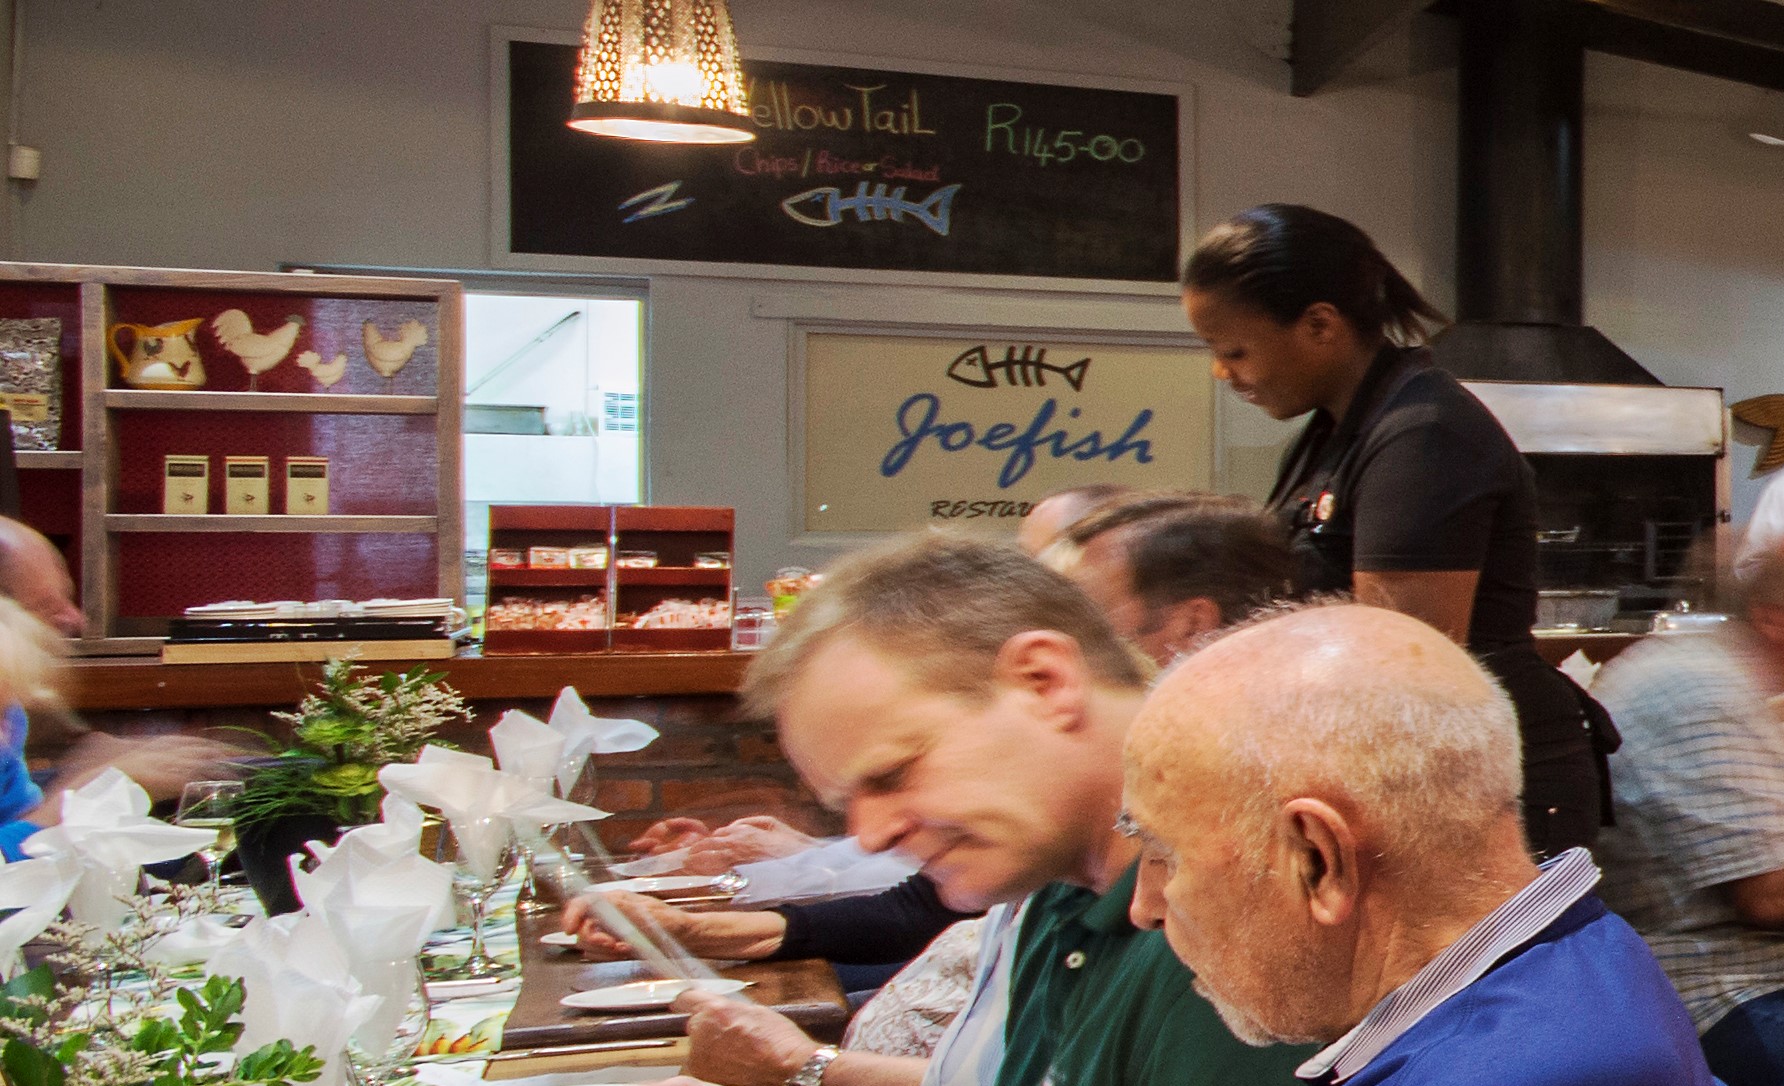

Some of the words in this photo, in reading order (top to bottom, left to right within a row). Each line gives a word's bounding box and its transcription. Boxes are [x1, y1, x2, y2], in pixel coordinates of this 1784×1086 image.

[749, 75, 853, 132] ellow
[880, 393, 1155, 489] Joefish
[931, 500, 1036, 519] RESTAU
